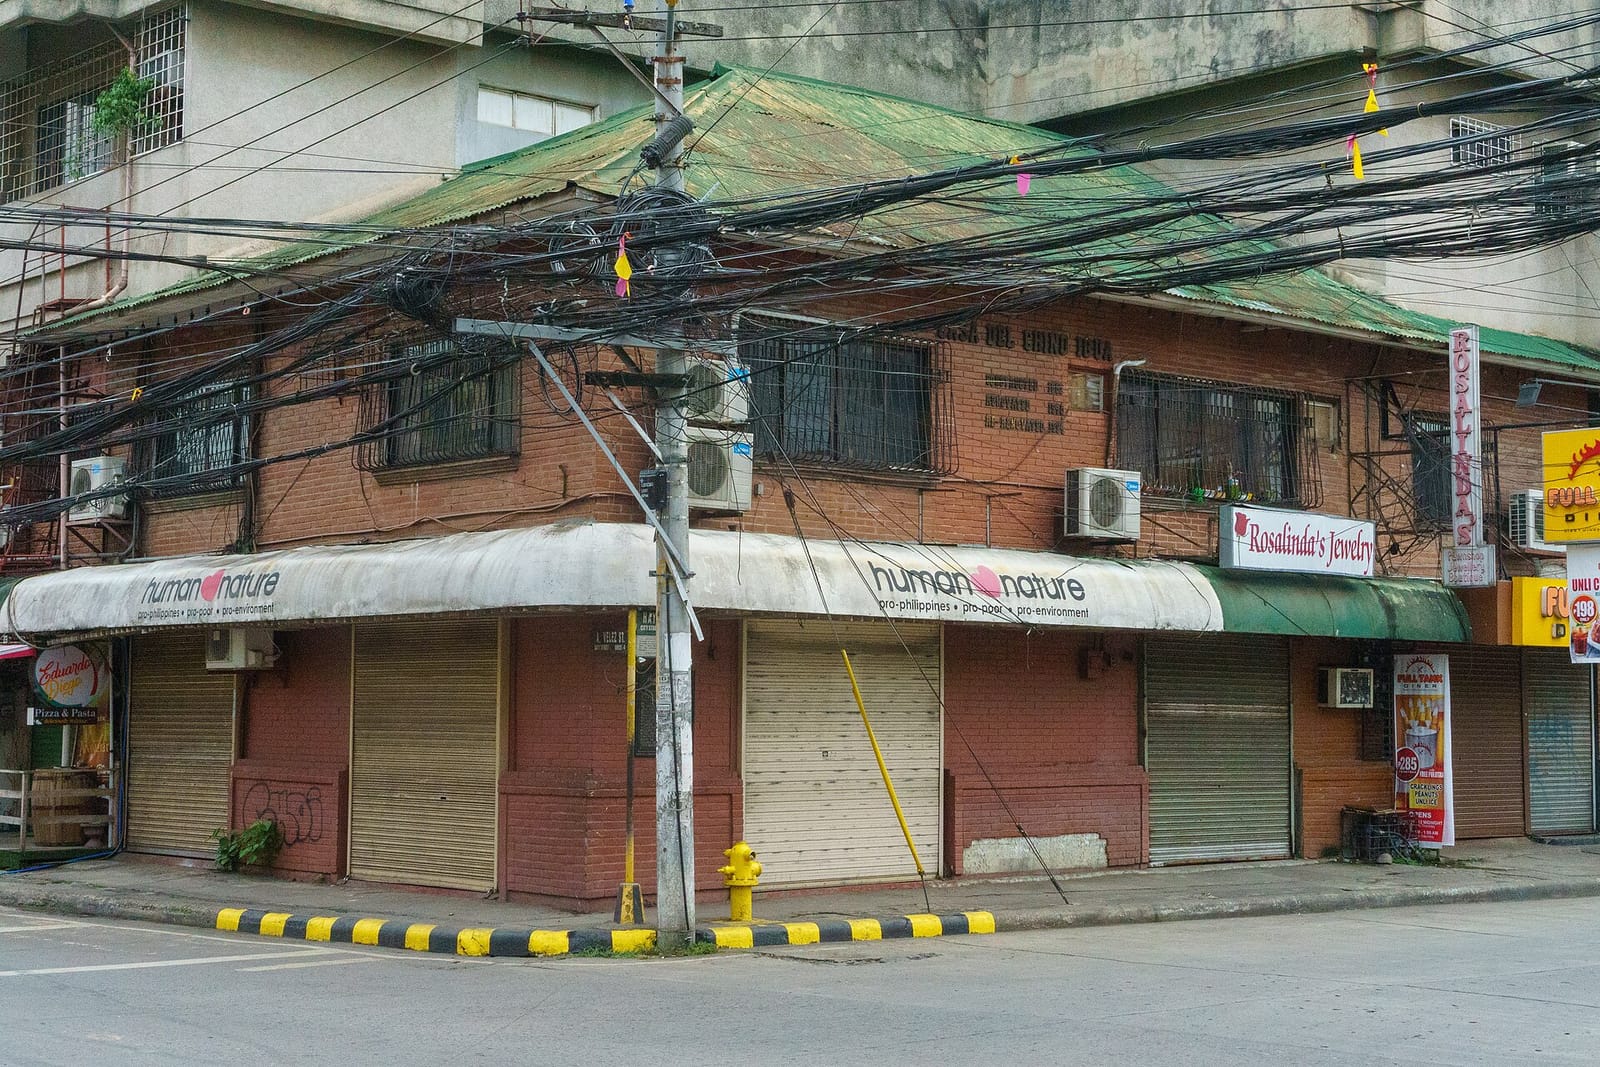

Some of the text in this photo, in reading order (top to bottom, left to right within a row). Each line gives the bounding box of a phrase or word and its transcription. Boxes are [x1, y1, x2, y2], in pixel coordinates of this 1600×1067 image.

[1548, 486, 1597, 508] FULL
[1249, 522, 1373, 575] Rosalinda's Jewelry
[141, 570, 280, 604] human nature
[868, 561, 1085, 601] human nature
[1572, 578, 1591, 591] UNLI
[138, 602, 274, 620] pro-philippines pro-poor pro-environment
[879, 599, 1089, 618] pro-philippines pro-poor pro-environment
[39, 654, 90, 685] Eduardo
[1397, 674, 1418, 683] FULL
[45, 677, 82, 700] Diego
[35, 708, 96, 717] Pizza & Pasta
[1410, 783, 1443, 791] CRACKLINGS
